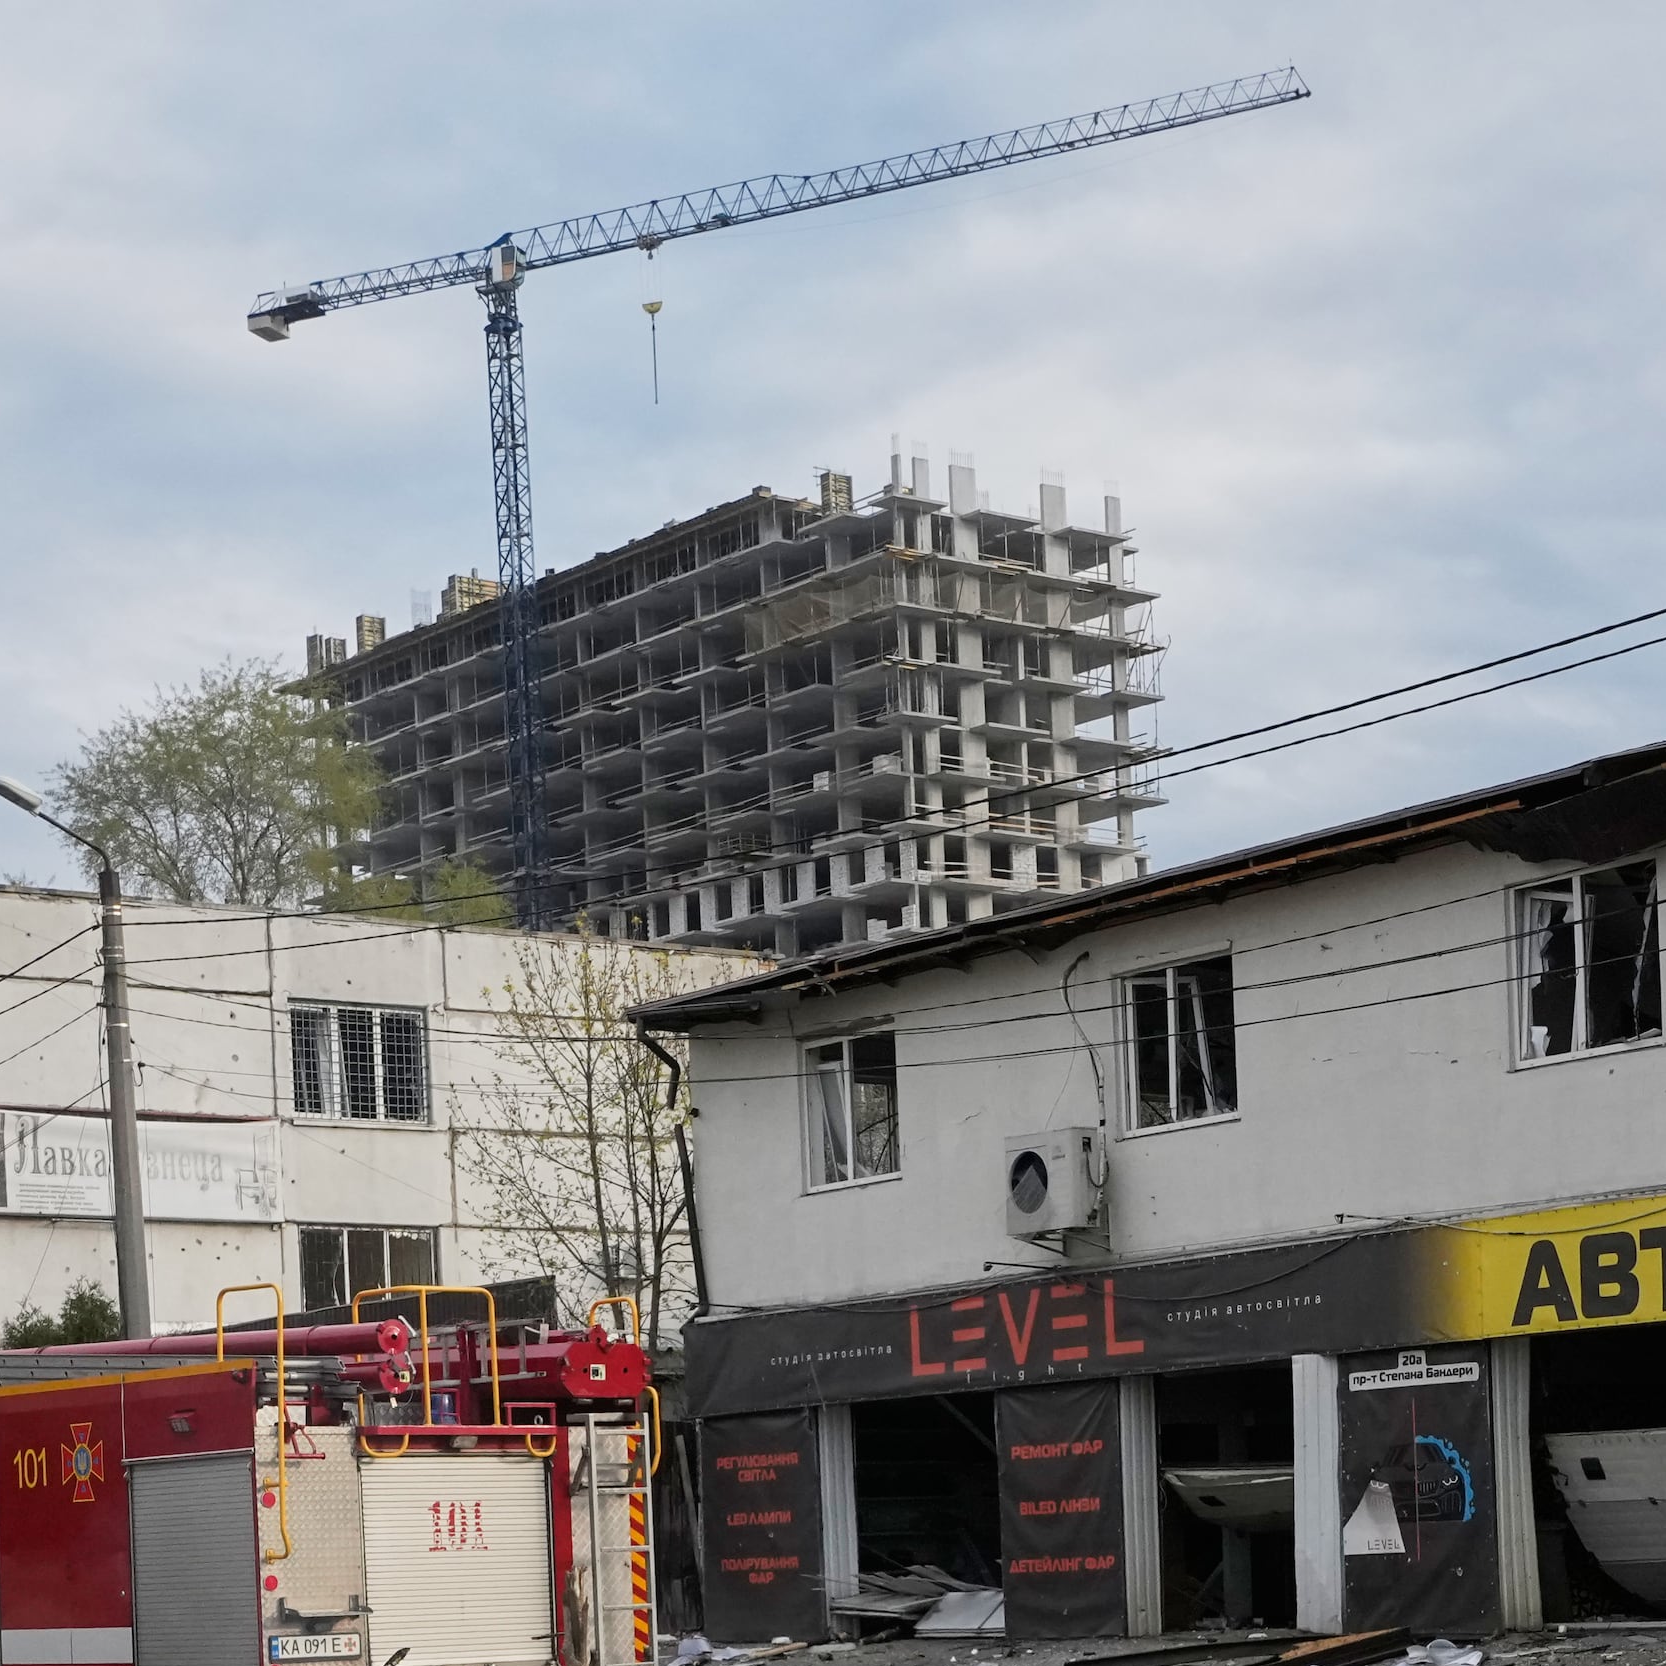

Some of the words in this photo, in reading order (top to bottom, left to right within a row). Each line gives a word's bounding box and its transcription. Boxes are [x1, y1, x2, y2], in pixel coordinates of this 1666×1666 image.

[13, 1115, 107, 1177] Лавка
[145, 1151, 223, 1191] знеца
[1167, 1307, 1218, 1322] студія
[1226, 1294, 1322, 1316] автосвітла
[910, 1279, 1144, 1376] LEVEL
[770, 1353, 813, 1366] студія
[1402, 1355, 1422, 1366] 20а
[1353, 1374, 1377, 1386] пр-т
[1379, 1371, 1423, 1383] Степана
[1426, 1366, 1473, 1379] Бандери
[1011, 1442, 1069, 1460] РЕМОНТ
[1071, 1440, 1103, 1455] ФАР
[14, 1447, 47, 1489] 101
[717, 1452, 799, 1470] РЕГУЛЮВАННЯ
[738, 1469, 777, 1482] СВІТЛА
[1059, 1497, 1101, 1514] ЛІНЗИ
[727, 1513, 747, 1526] LED
[749, 1510, 792, 1525] ЛАМПИ
[1367, 1539, 1401, 1551] LEVEL
[721, 1556, 799, 1571] ПОЛІРУВАННЯ
[1009, 1556, 1082, 1574] ДЕТЕЙЛІНГ
[1085, 1556, 1115, 1570] ФАР
[749, 1571, 774, 1584] ФАР
[304, 1638, 327, 1654] 091
